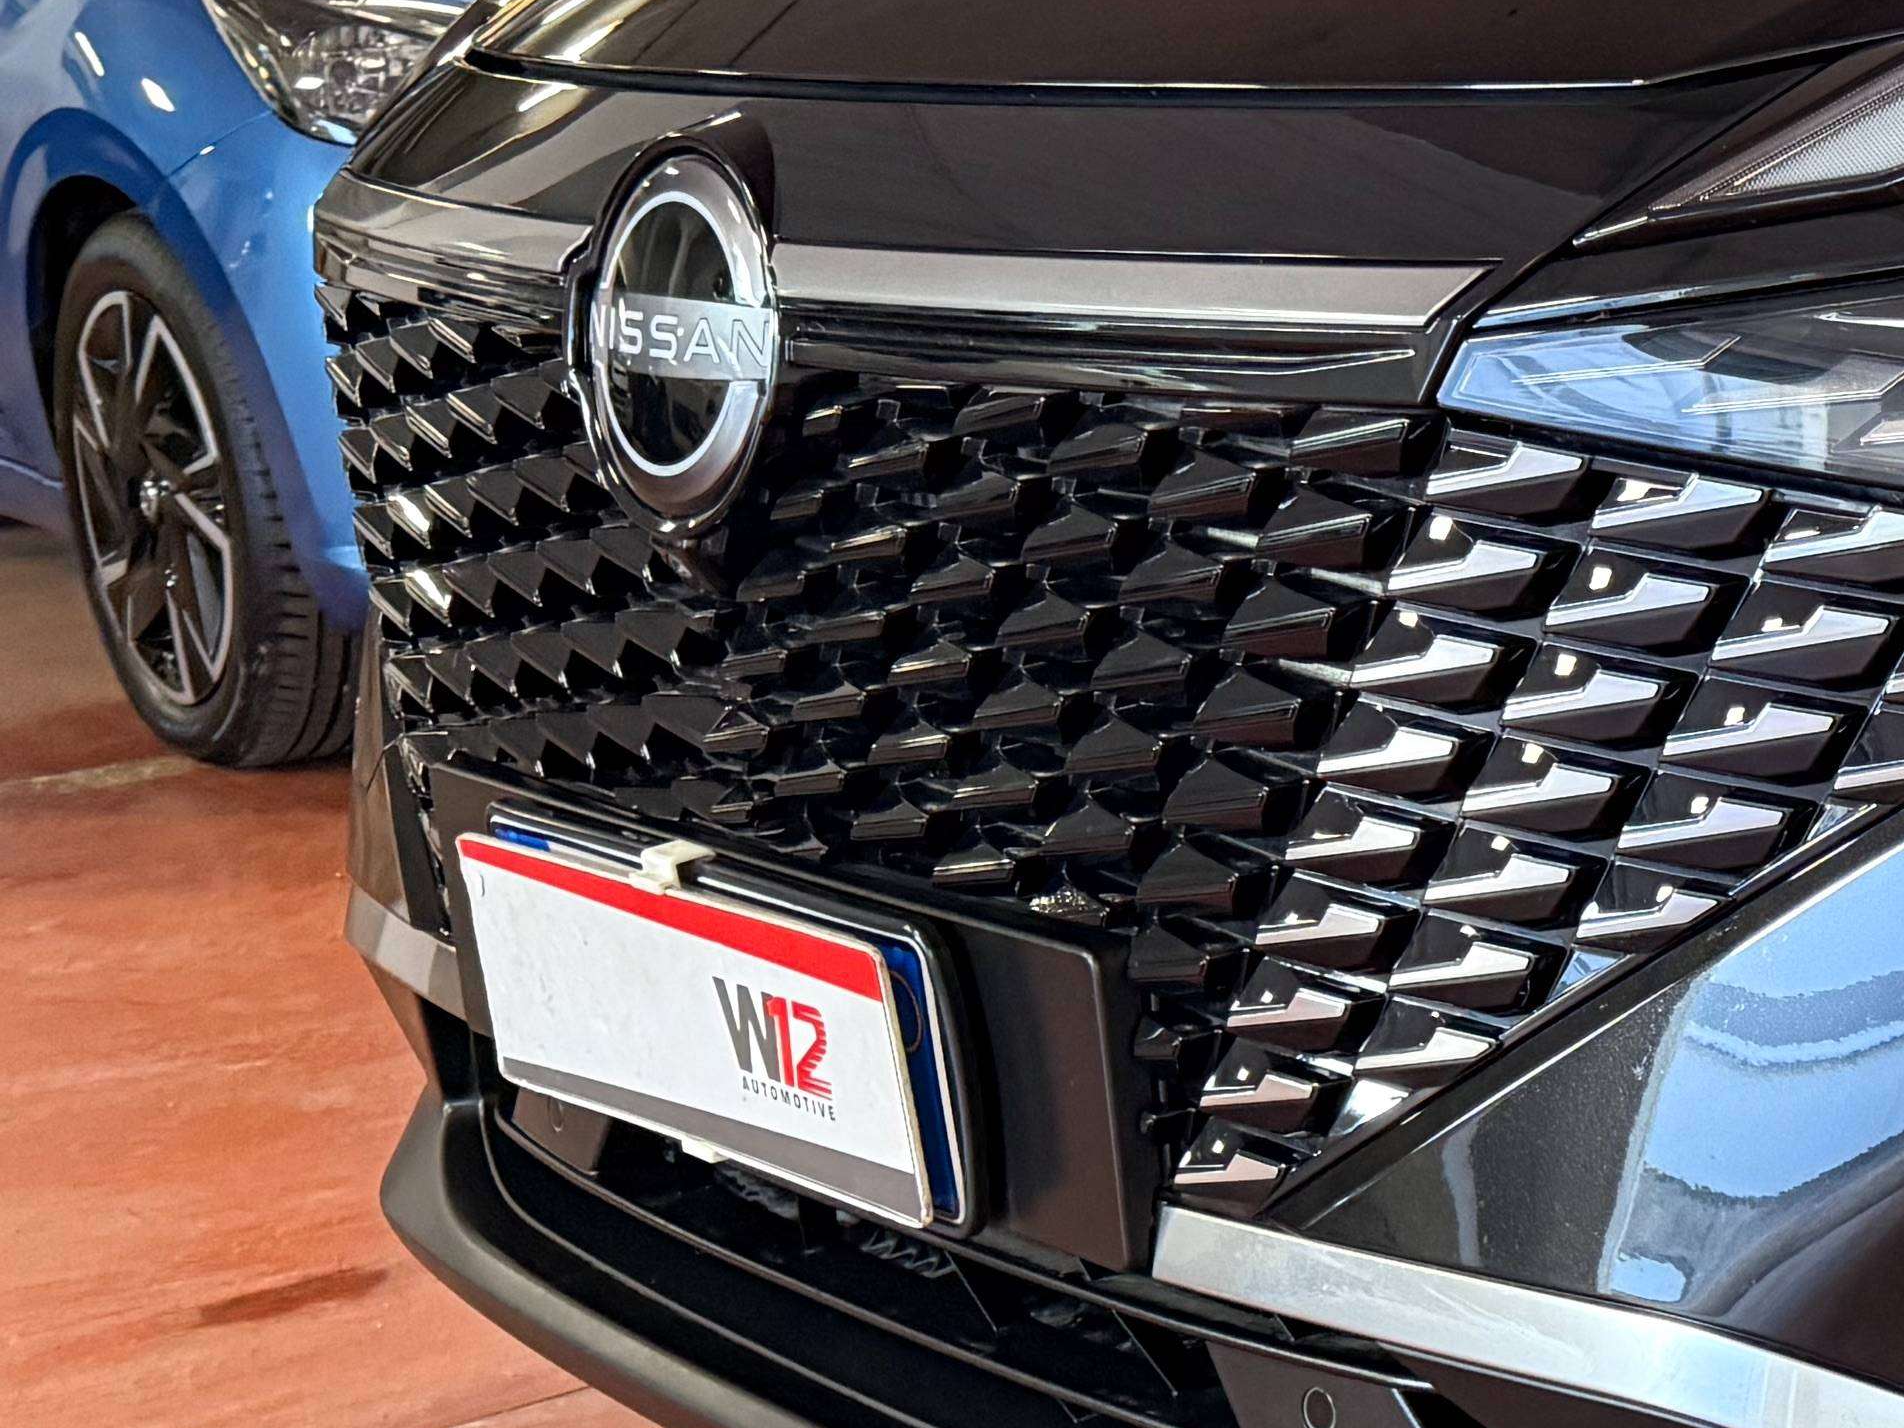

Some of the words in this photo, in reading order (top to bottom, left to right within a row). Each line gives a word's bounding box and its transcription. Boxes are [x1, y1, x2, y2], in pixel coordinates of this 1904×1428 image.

[588, 298, 771, 368] NISSAN
[712, 976, 832, 1097] W12
[743, 1076, 836, 1121] AUTOMOTIVE
